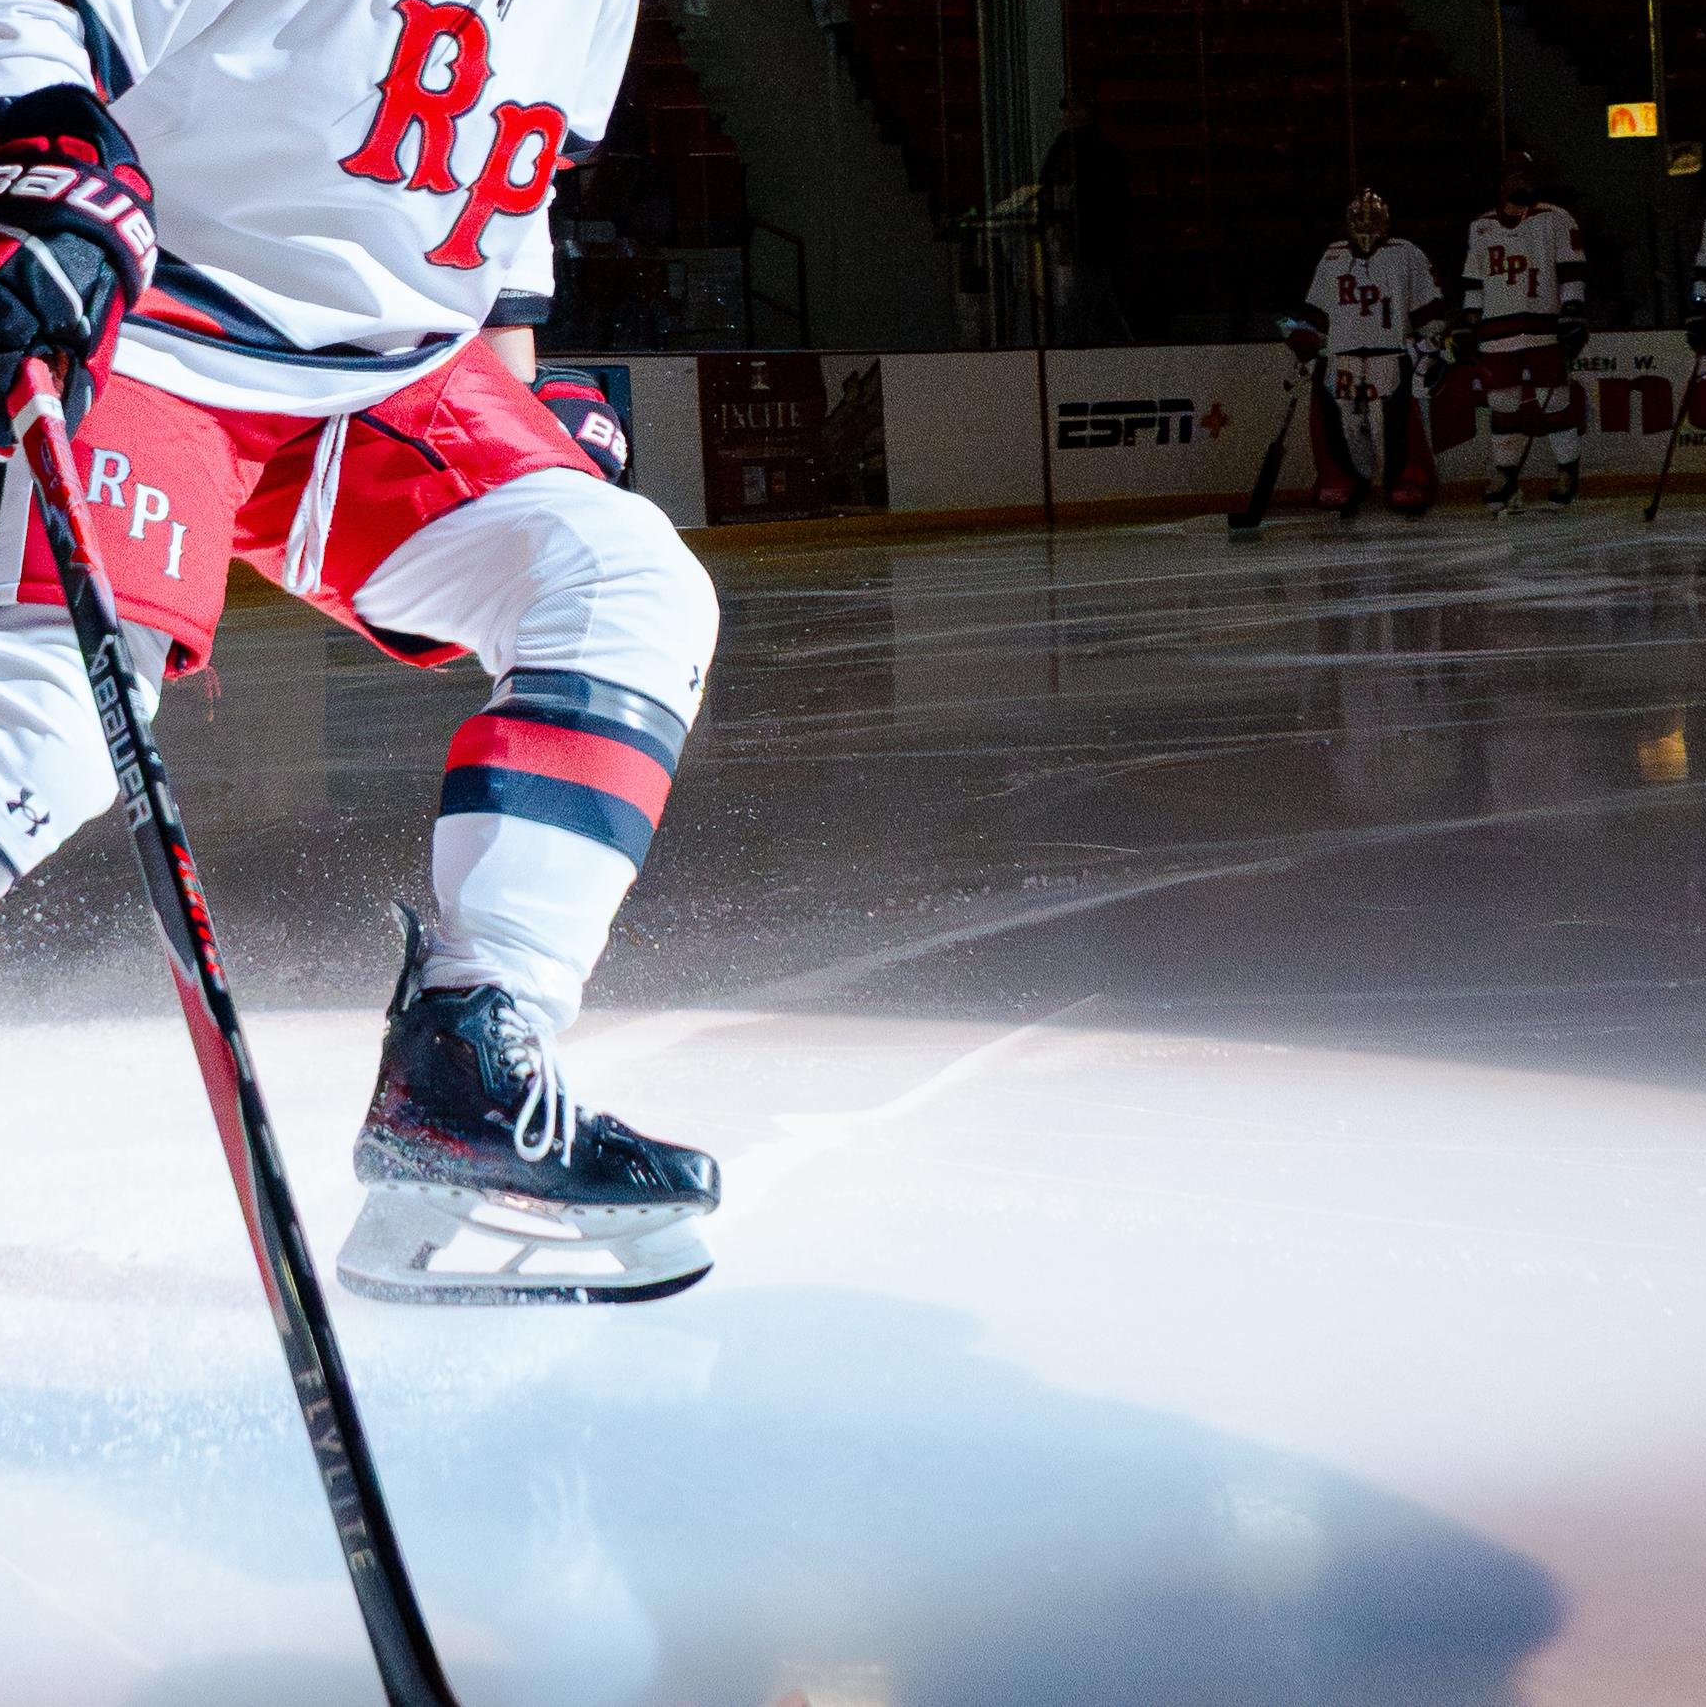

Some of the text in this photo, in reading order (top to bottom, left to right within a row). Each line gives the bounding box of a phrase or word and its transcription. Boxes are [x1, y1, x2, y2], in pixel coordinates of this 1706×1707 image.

[1336, 273, 1393, 330] RPI
[1487, 244, 1540, 299] RPI
[85, 446, 189, 581] RPI
[94, 673, 155, 831] BAUER
